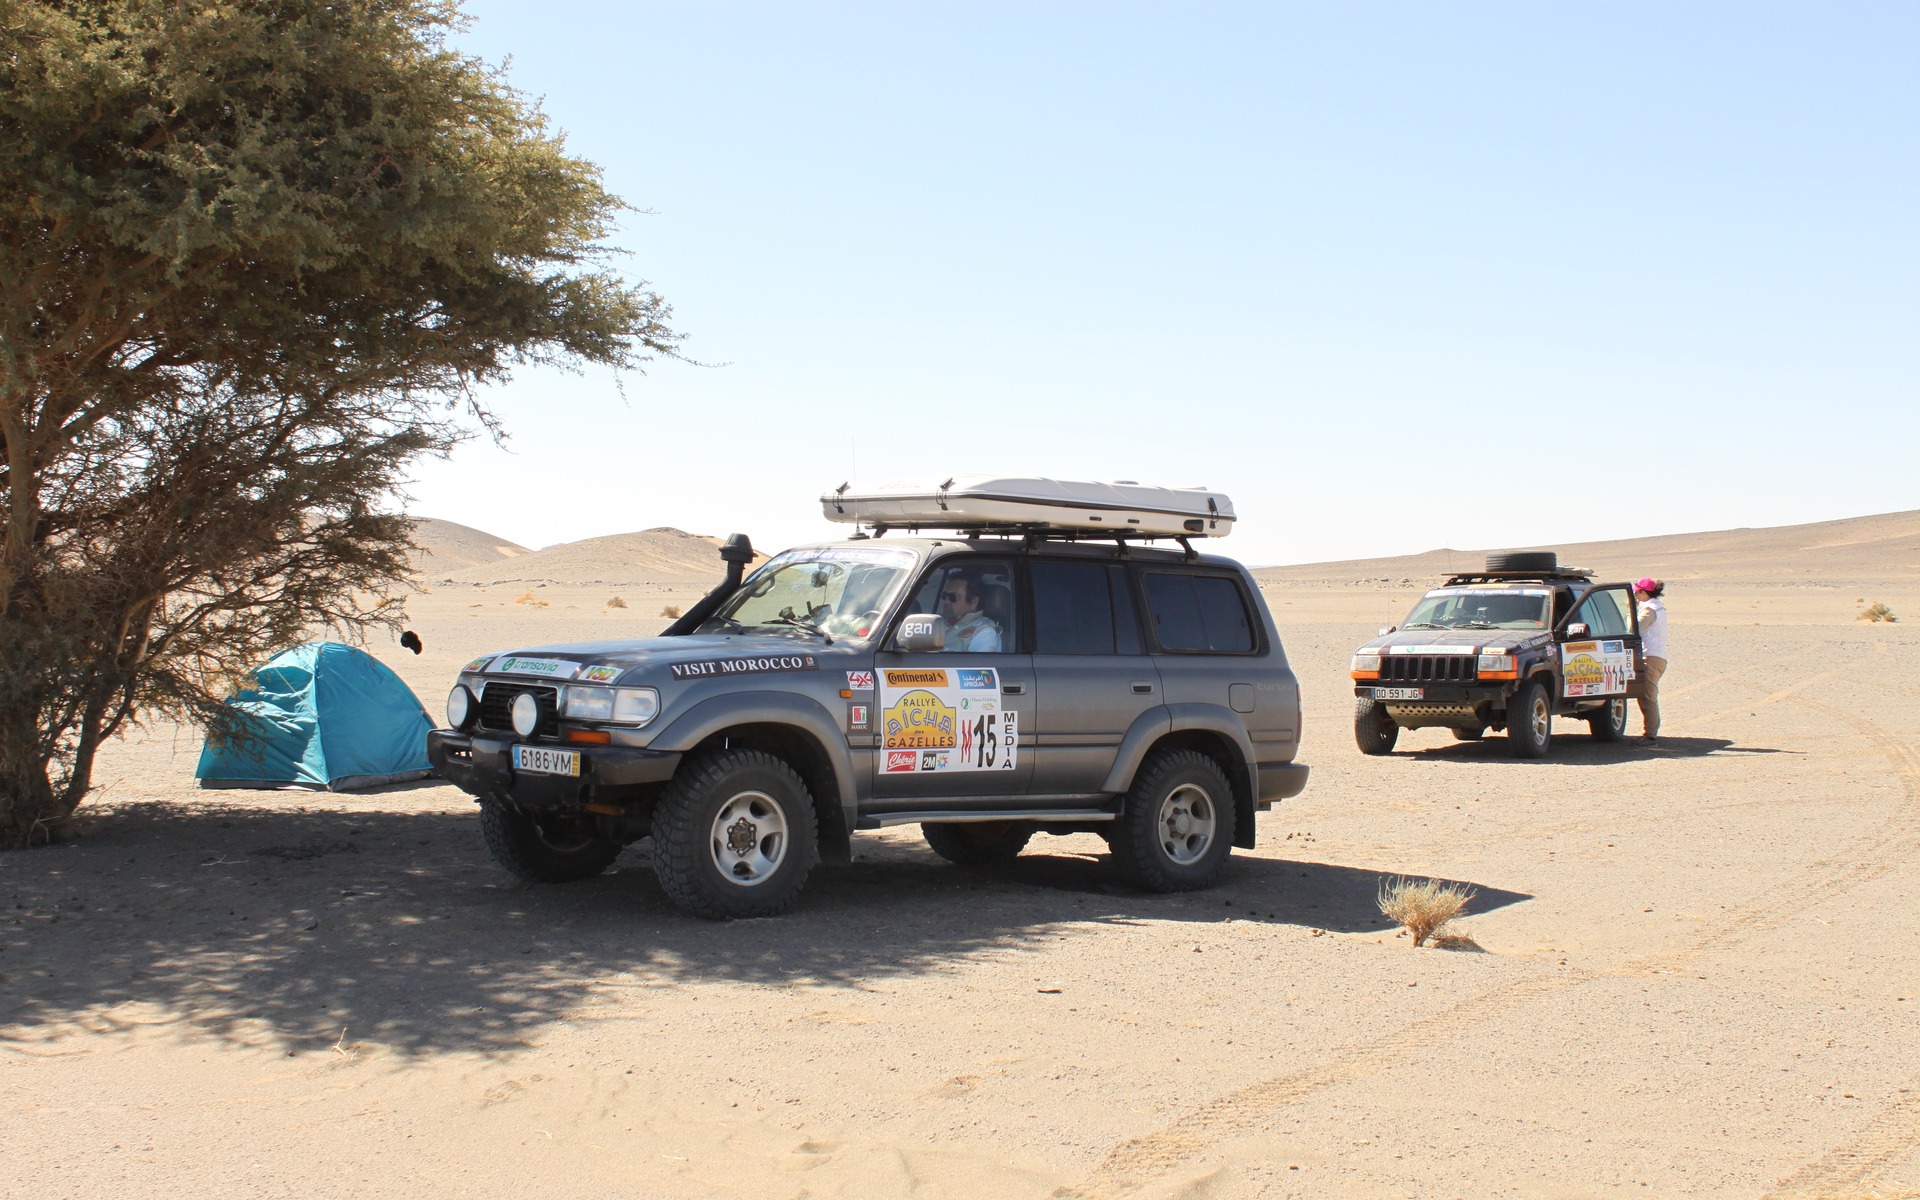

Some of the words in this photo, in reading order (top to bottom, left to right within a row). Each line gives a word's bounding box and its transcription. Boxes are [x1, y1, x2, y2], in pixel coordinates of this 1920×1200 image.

[905, 622, 933, 637] gan
[1568, 626, 1584, 635] gan
[514, 659, 559, 672] transavia
[672, 661, 716, 676] VISIT
[720, 656, 803, 673] MOROCCO
[585, 666, 617, 681] VSD
[887, 672, 937, 685] Continental
[903, 698, 936, 707] RALLYE
[887, 736, 954, 748] GAZELLES
[974, 714, 997, 768] 15
[1002, 712, 1015, 769] MEDIA
[922, 756, 936, 768] 2M
